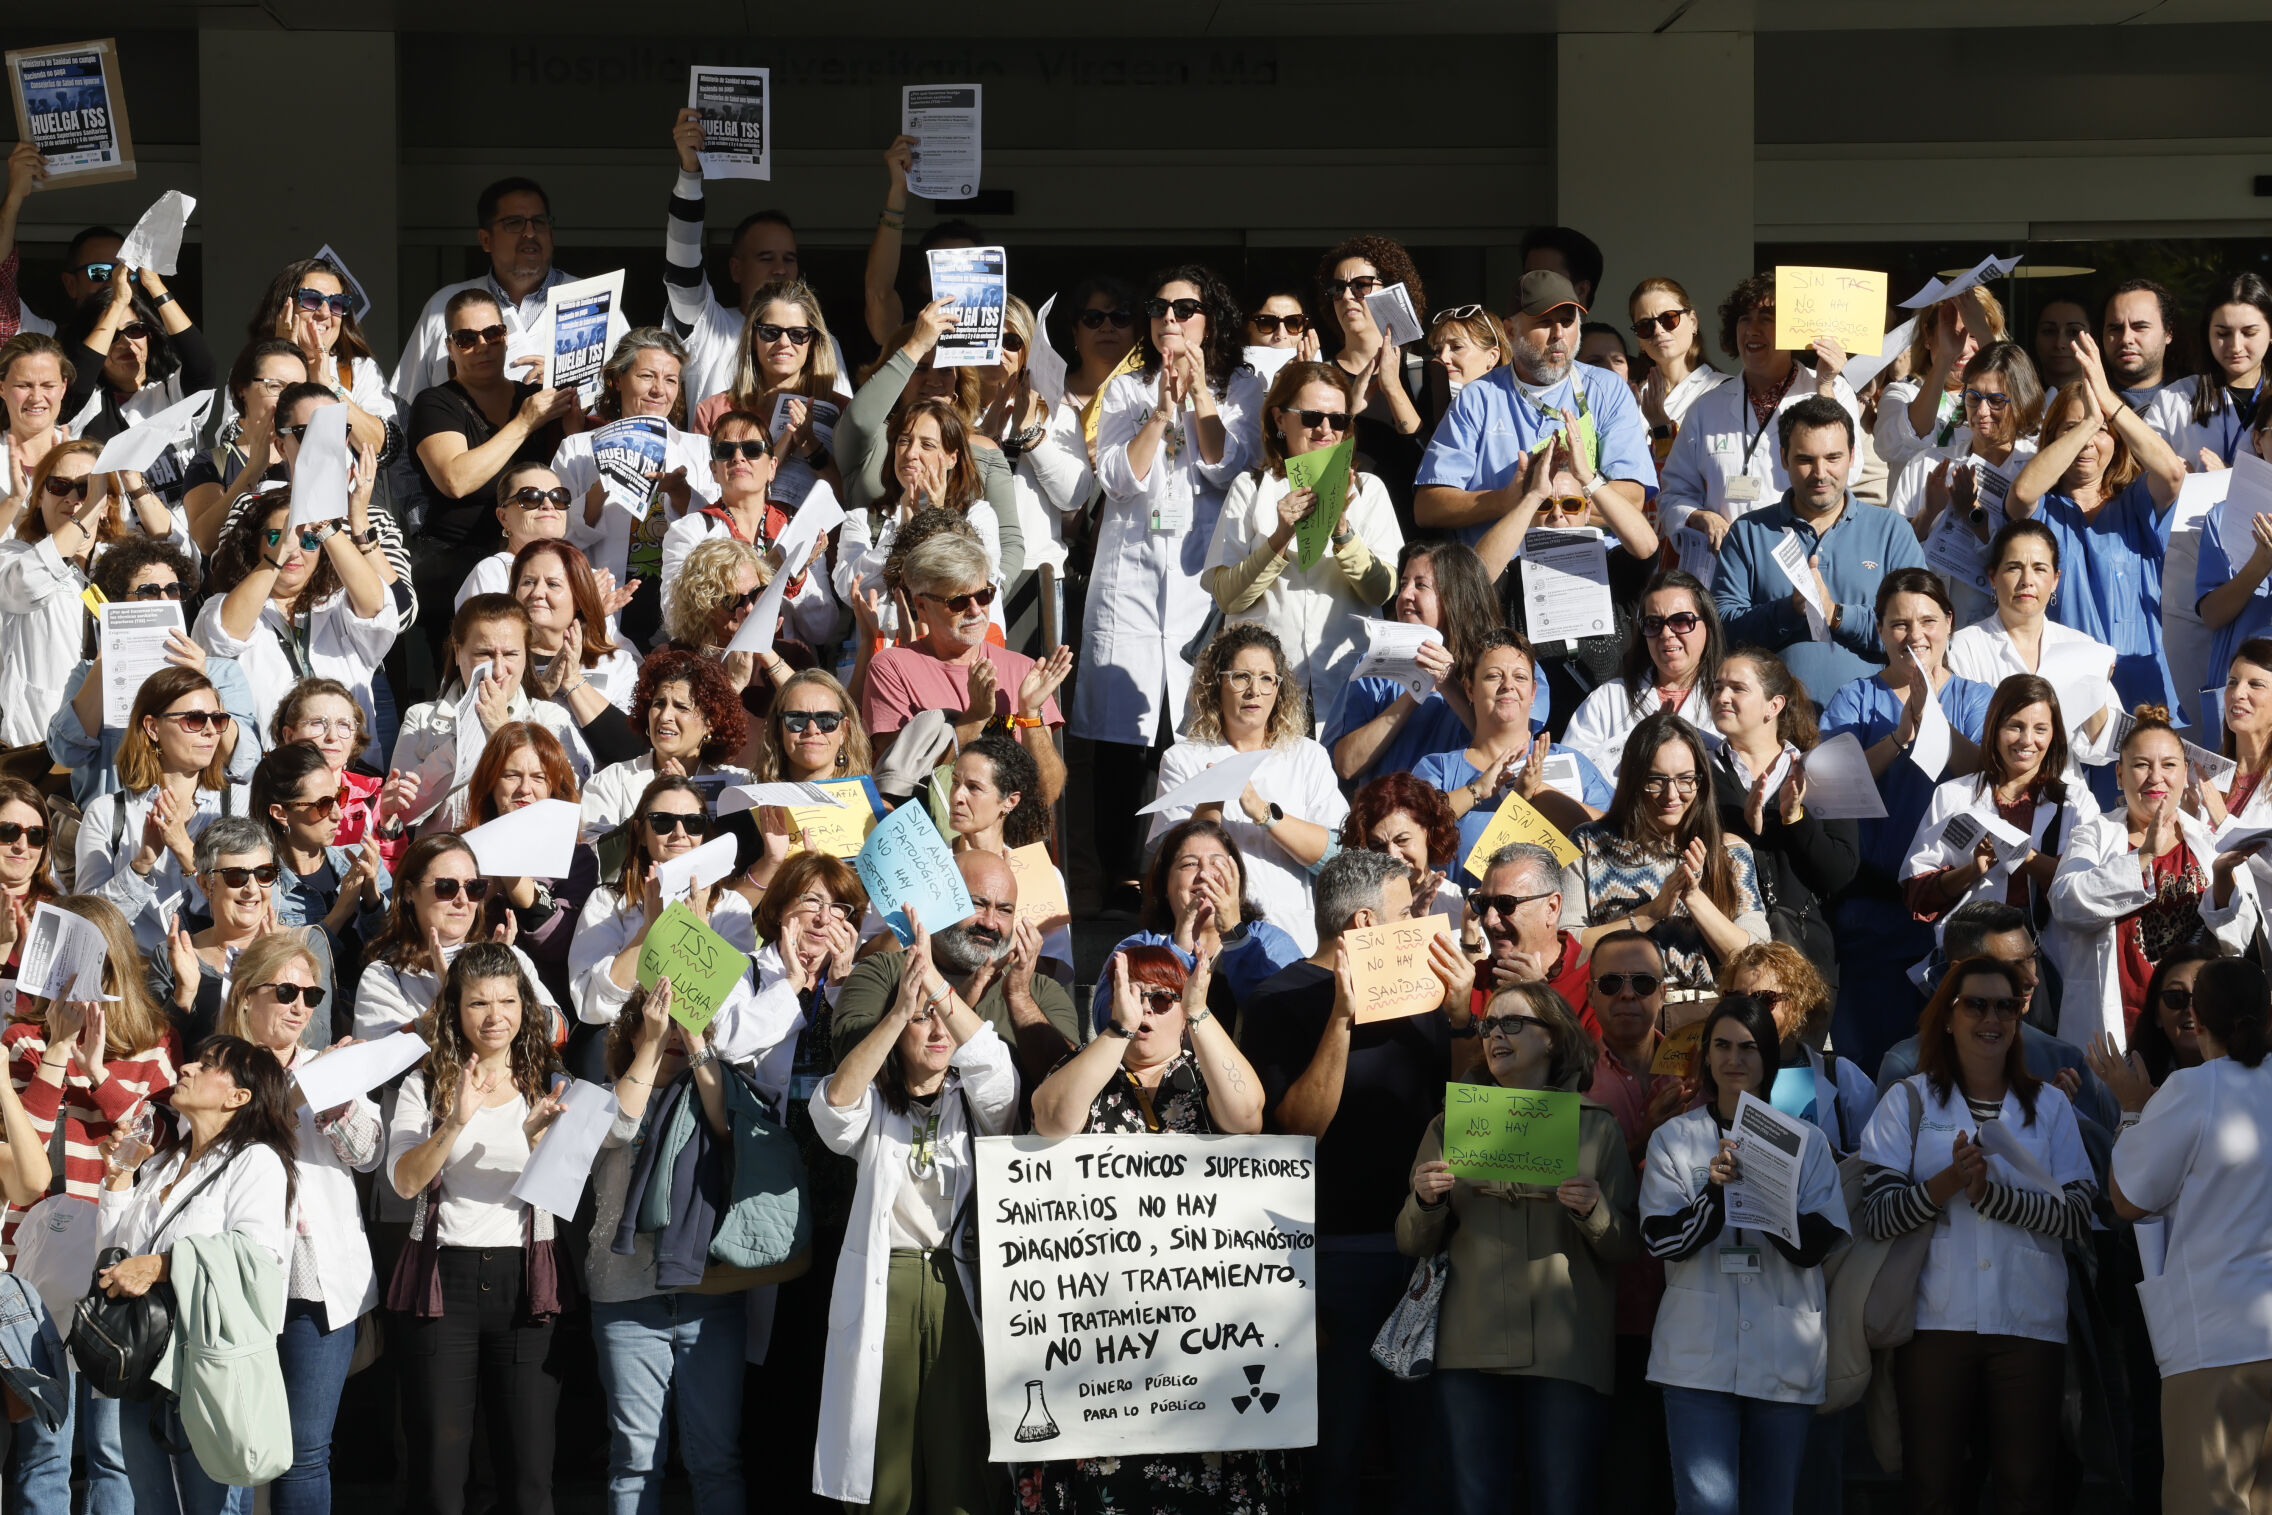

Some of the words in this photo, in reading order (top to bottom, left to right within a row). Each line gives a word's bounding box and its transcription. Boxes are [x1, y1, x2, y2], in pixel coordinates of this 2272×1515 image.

[31, 110, 80, 135] HUELGA
[81, 107, 106, 129] TSS
[741, 122, 760, 138] TSS
[1789, 270, 1824, 289] SIN
[1835, 277, 1875, 292] TAC
[1796, 294, 1815, 310] NO
[1830, 298, 1849, 312] HAY
[981, 306, 1000, 327] TSS
[556, 347, 587, 375] HUELGA
[588, 342, 604, 364] TSS
[597, 448, 642, 471] HUELGA
[1496, 830, 1510, 845] NO
[1507, 804, 1534, 829] SIN
[1538, 829, 1563, 858] TAC
[876, 837, 892, 856] NO
[894, 868, 914, 890] HAY
[892, 822, 942, 902] PATOLÓGICA
[906, 806, 932, 837] SIN
[927, 846, 966, 913] ANATOMÍA
[862, 853, 898, 909] CERTEZAS
[1354, 931, 1385, 950] SIN
[1392, 928, 1423, 944] TSS
[644, 948, 670, 975] EN
[1367, 956, 1384, 972] NO
[1396, 954, 1413, 968] HAY
[1368, 977, 1436, 1002] SANIDAD
[1456, 1086, 1489, 1104] SIN
[1506, 1096, 1549, 1112] TSS
[1470, 1117, 1490, 1131] NO
[1505, 1120, 1528, 1136] HAY
[1007, 1157, 1052, 1184] SIN
[1074, 1144, 1188, 1179] TÉCNICOS
[1203, 1154, 1313, 1180] SUPERIORES
[1450, 1146, 1564, 1169] DIAGNÓSTICOS
[996, 1192, 1118, 1226] SANITARIOS
[1138, 1194, 1167, 1218] NO
[1176, 1192, 1218, 1219] HAY
[1169, 1224, 1208, 1251] SIN
[1214, 1224, 1315, 1251] DIAGNÓSTICO
[1010, 1278, 1046, 1302] NO
[1057, 1270, 1110, 1300] HAY
[1009, 1308, 1047, 1338] SIN
[1057, 1300, 1198, 1334] TRATAMIENTO
[1044, 1336, 1082, 1372] NO
[1096, 1328, 1160, 1365] HAY
[1078, 1378, 1134, 1398] DINERO
[1144, 1373, 1199, 1391] PÚBLICO
[1082, 1408, 1118, 1422] PARA
[1124, 1405, 1140, 1418] LO
[1150, 1399, 1207, 1414] PÚBLICO
